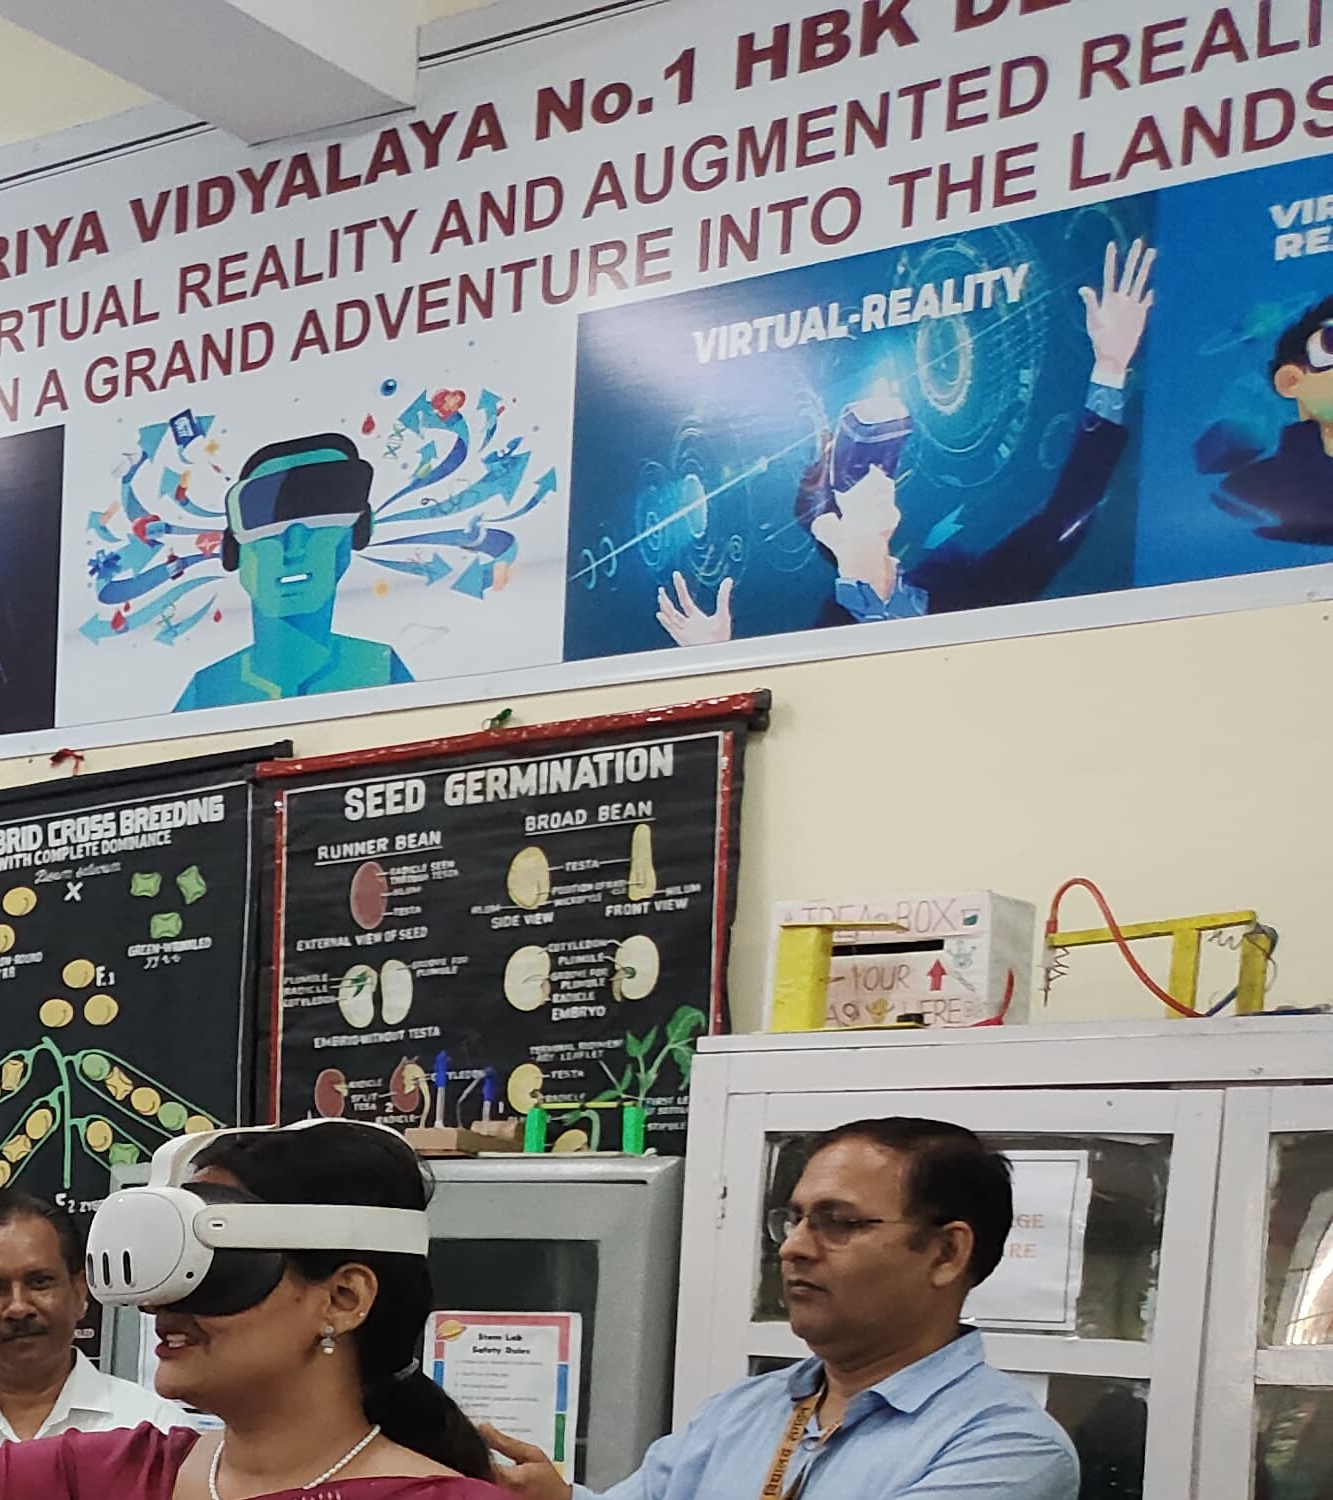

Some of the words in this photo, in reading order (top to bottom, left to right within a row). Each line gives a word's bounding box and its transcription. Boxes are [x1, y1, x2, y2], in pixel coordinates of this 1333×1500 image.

[130, 103, 508, 243] VIDYALAYA
[535, 46, 696, 142] No.1
[735, 0, 919, 90] HBK
[178, 208, 417, 313] REALITY
[431, 174, 564, 257] AND
[583, 55, 1049, 220] AUGMENTED
[32, 367, 69, 417] A
[83, 319, 275, 401] GRAND
[289, 238, 672, 373] ADVENTURE
[699, 187, 862, 273] INTO
[889, 142, 1038, 231] THE
[693, 263, 1031, 366] VIRTUAL-REALITY
[344, 778, 426, 821] SEED
[444, 744, 675, 808] GERMINATION
[47, 810, 117, 847] CROSS
[119, 795, 225, 836] BREEDING
[525, 808, 588, 832] BROAD
[597, 800, 654, 822] BEAN
[33, 841, 100, 865] COMPLETE
[317, 837, 388, 861] RUNNER
[395, 830, 442, 852] BEAN
[491, 914, 520, 930] SIDE
[524, 911, 555, 925] VIEW
[605, 901, 650, 918] FRONT
[655, 898, 690, 912] VIEW
[896, 898, 958, 933] BOX
[296, 935, 352, 951] EXTERNAL
[355, 932, 383, 946] VIEW
[384, 929, 398, 943] OF
[399, 926, 429, 941] SEED
[551, 1006, 607, 1021] EMBRYO
[409, 1026, 441, 1039] TESTA
